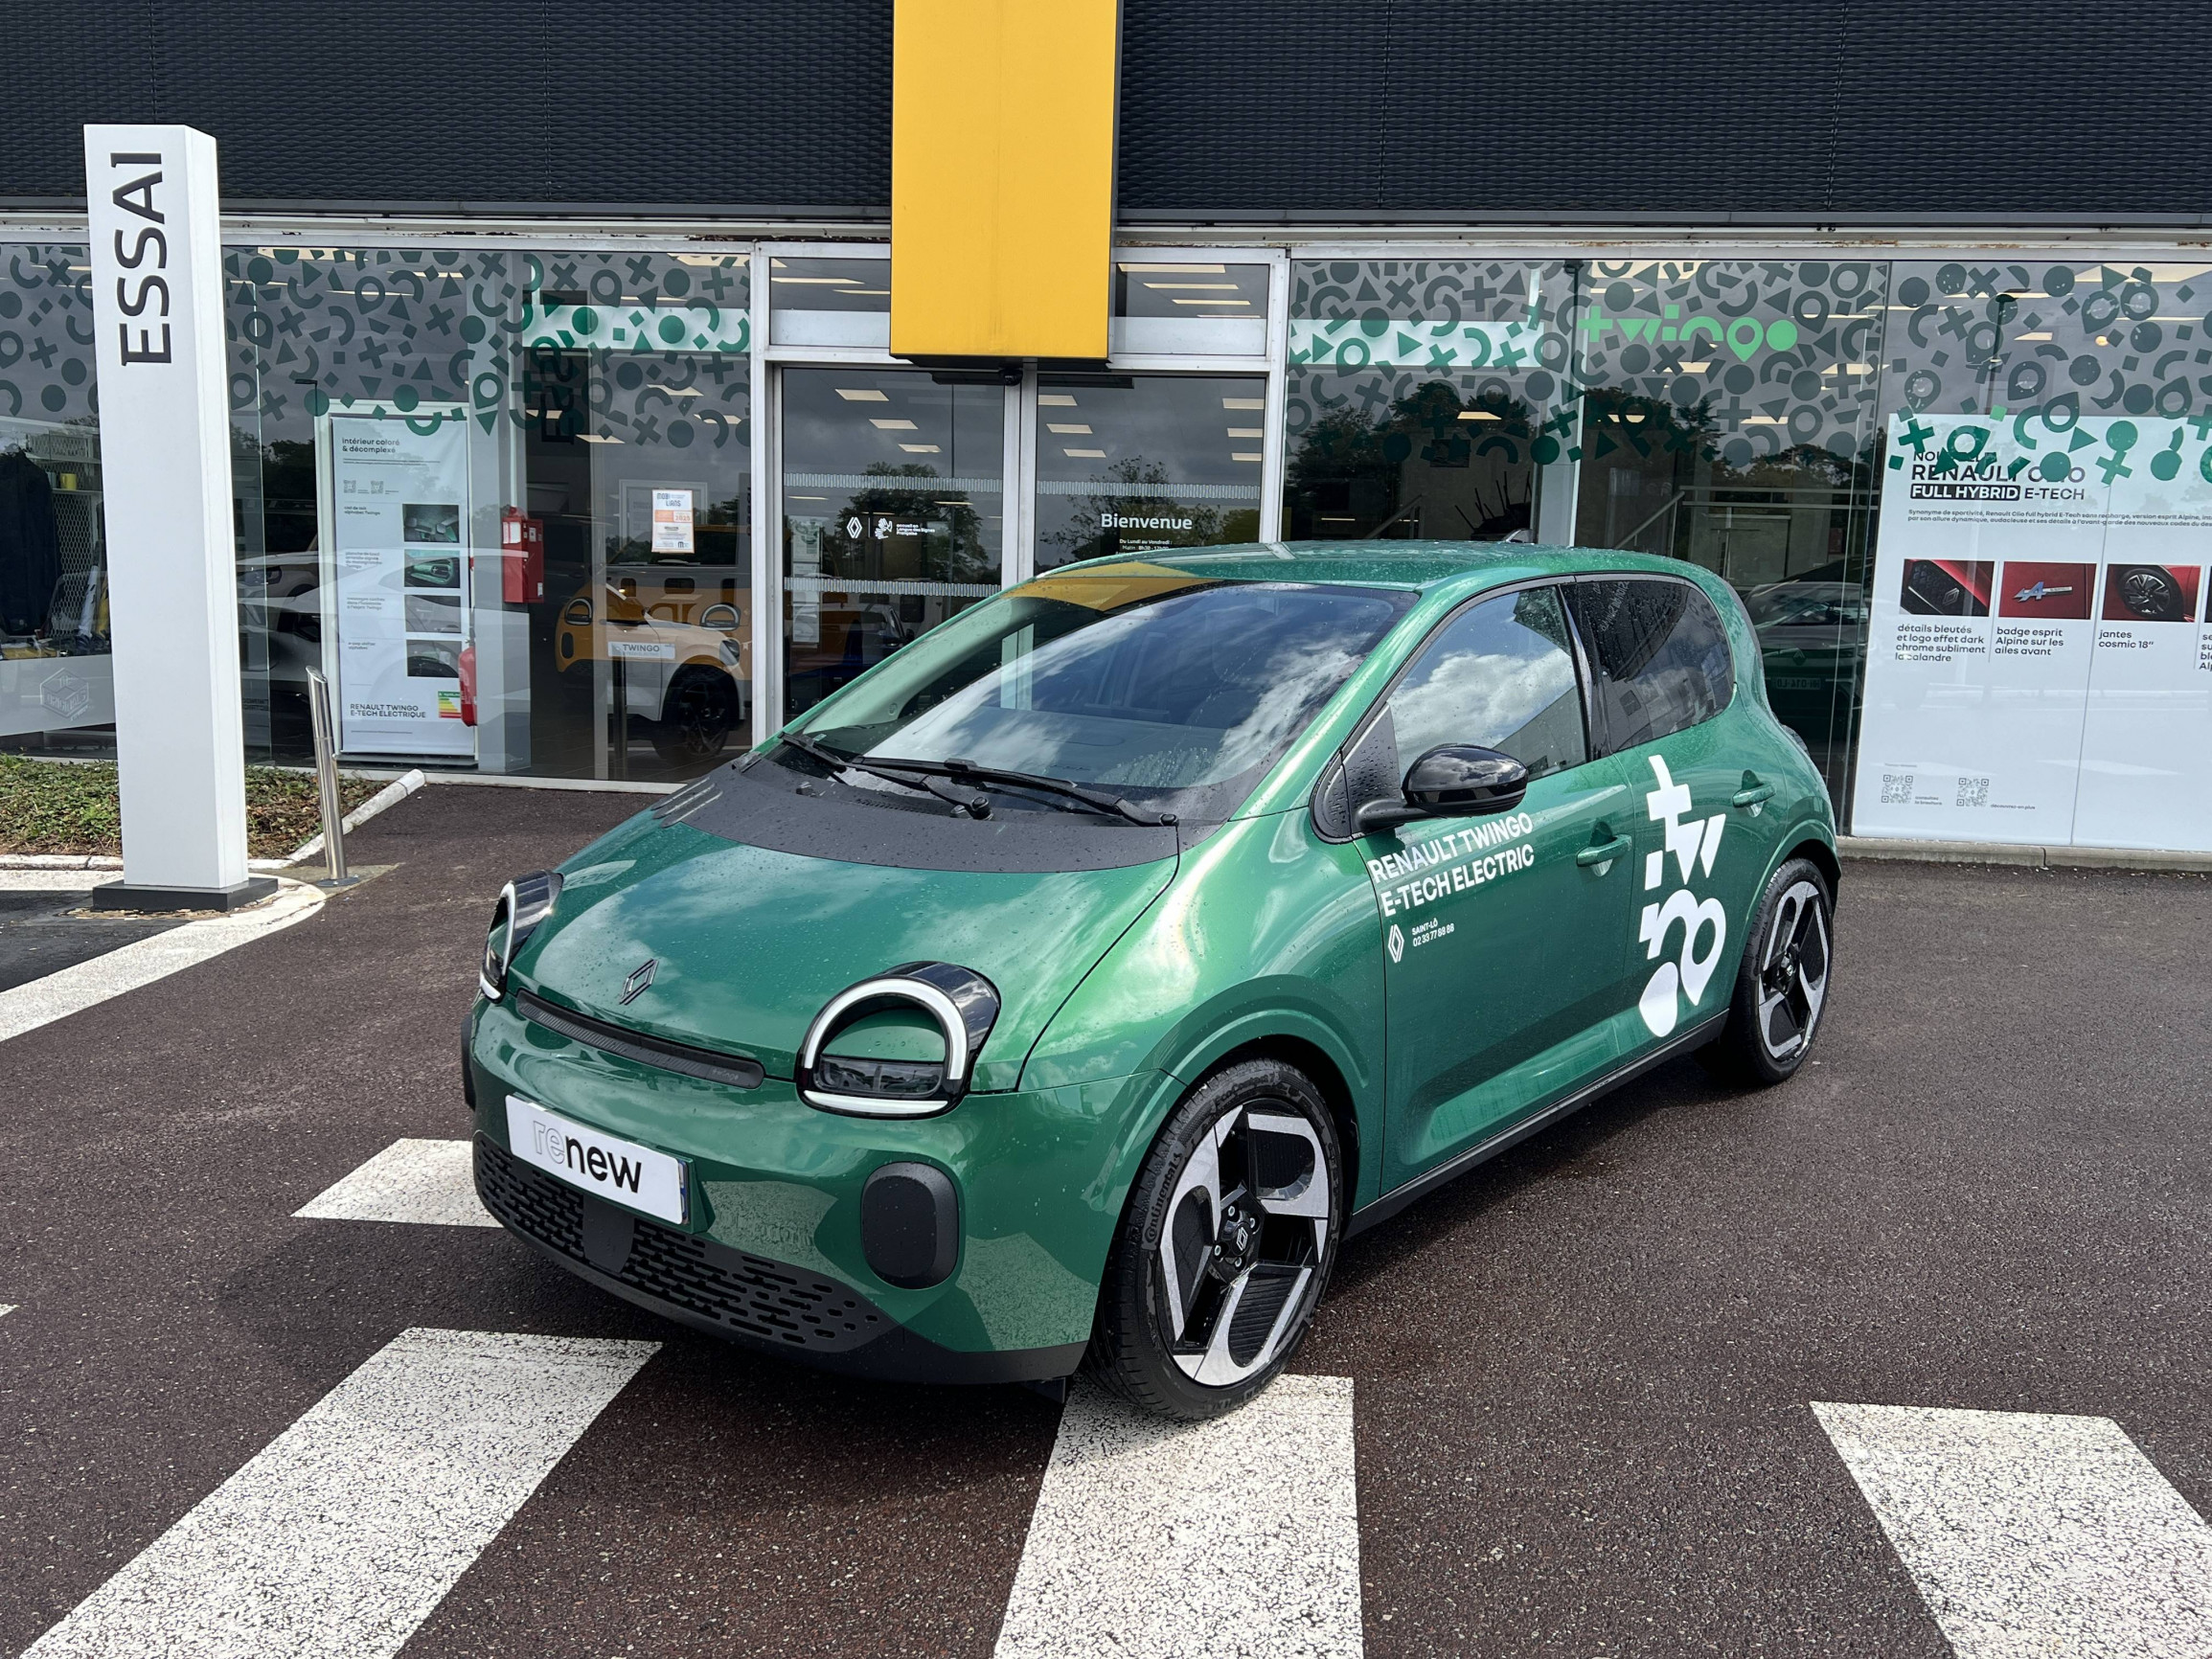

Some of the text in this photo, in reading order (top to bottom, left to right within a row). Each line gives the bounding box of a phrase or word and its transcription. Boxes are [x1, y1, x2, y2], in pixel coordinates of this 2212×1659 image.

[110, 152, 171, 366] ESSAI
[1576, 304, 1798, 363] twingo
[1912, 485, 2085, 500] FULL HYBRID E-TECH
[1101, 512, 1193, 530] Bienvenue
[1897, 624, 1973, 633] détails bleutés
[1996, 626, 2063, 638] badge esprit
[2098, 629, 2132, 640] jantes
[1909, 633, 1931, 645] logo
[1933, 634, 1958, 644] effet
[1960, 634, 1984, 644] dark
[1995, 636, 2029, 647] Alpine
[2049, 638, 2064, 647] les
[2098, 639, 2136, 648] cosmic
[623, 644, 660, 652] TWINGO
[1895, 643, 1986, 653] chrome subliment
[1995, 646, 2052, 656] ailes avant
[1366, 812, 1534, 883] RENAULT TWINGO
[1380, 843, 1535, 918] E-TECH ELECTRIC
[1413, 936, 1422, 947] 02
[1422, 932, 1430, 943] 33
[1430, 929, 1438, 940] 77
[1447, 922, 1455, 934] 88
[533, 1120, 642, 1193] renew
[1146, 1163, 1180, 1244] Continental
